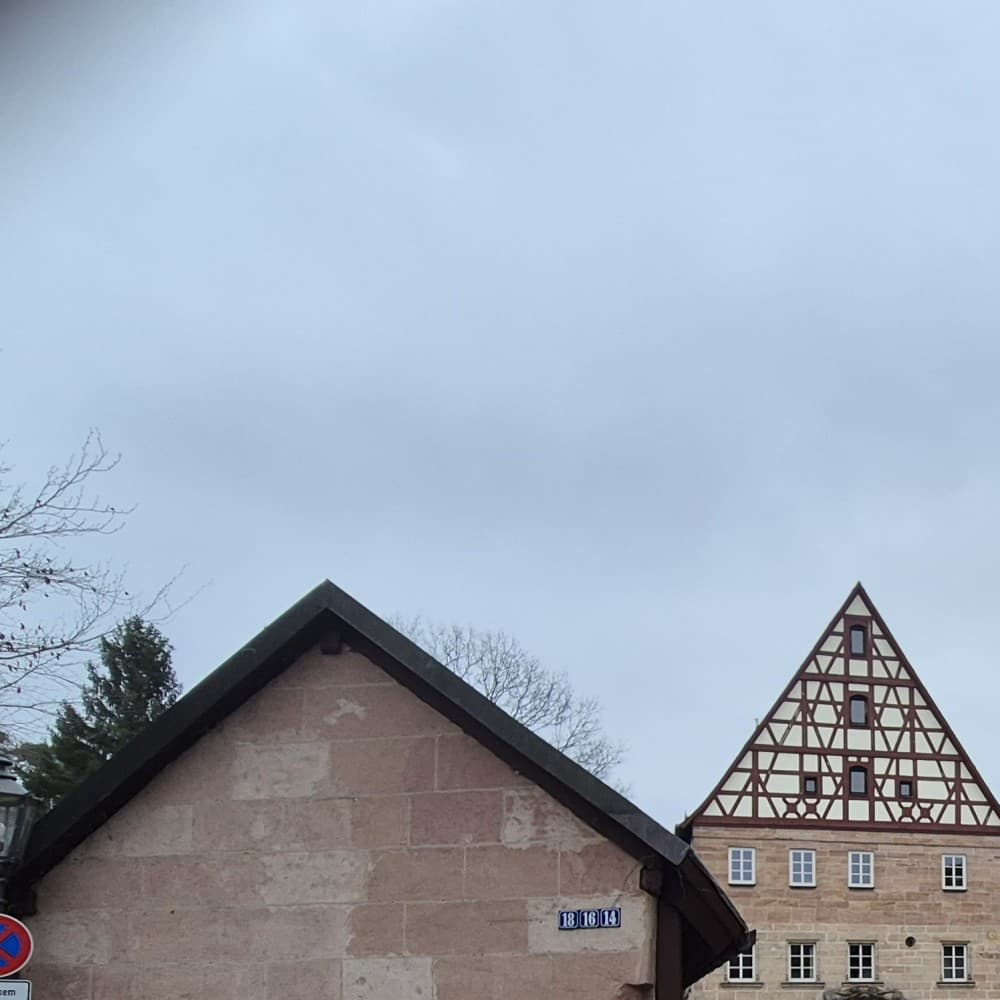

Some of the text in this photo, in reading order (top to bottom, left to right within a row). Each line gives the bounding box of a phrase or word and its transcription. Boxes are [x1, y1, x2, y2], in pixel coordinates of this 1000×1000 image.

[562, 910, 617, 927] 18 16 14
